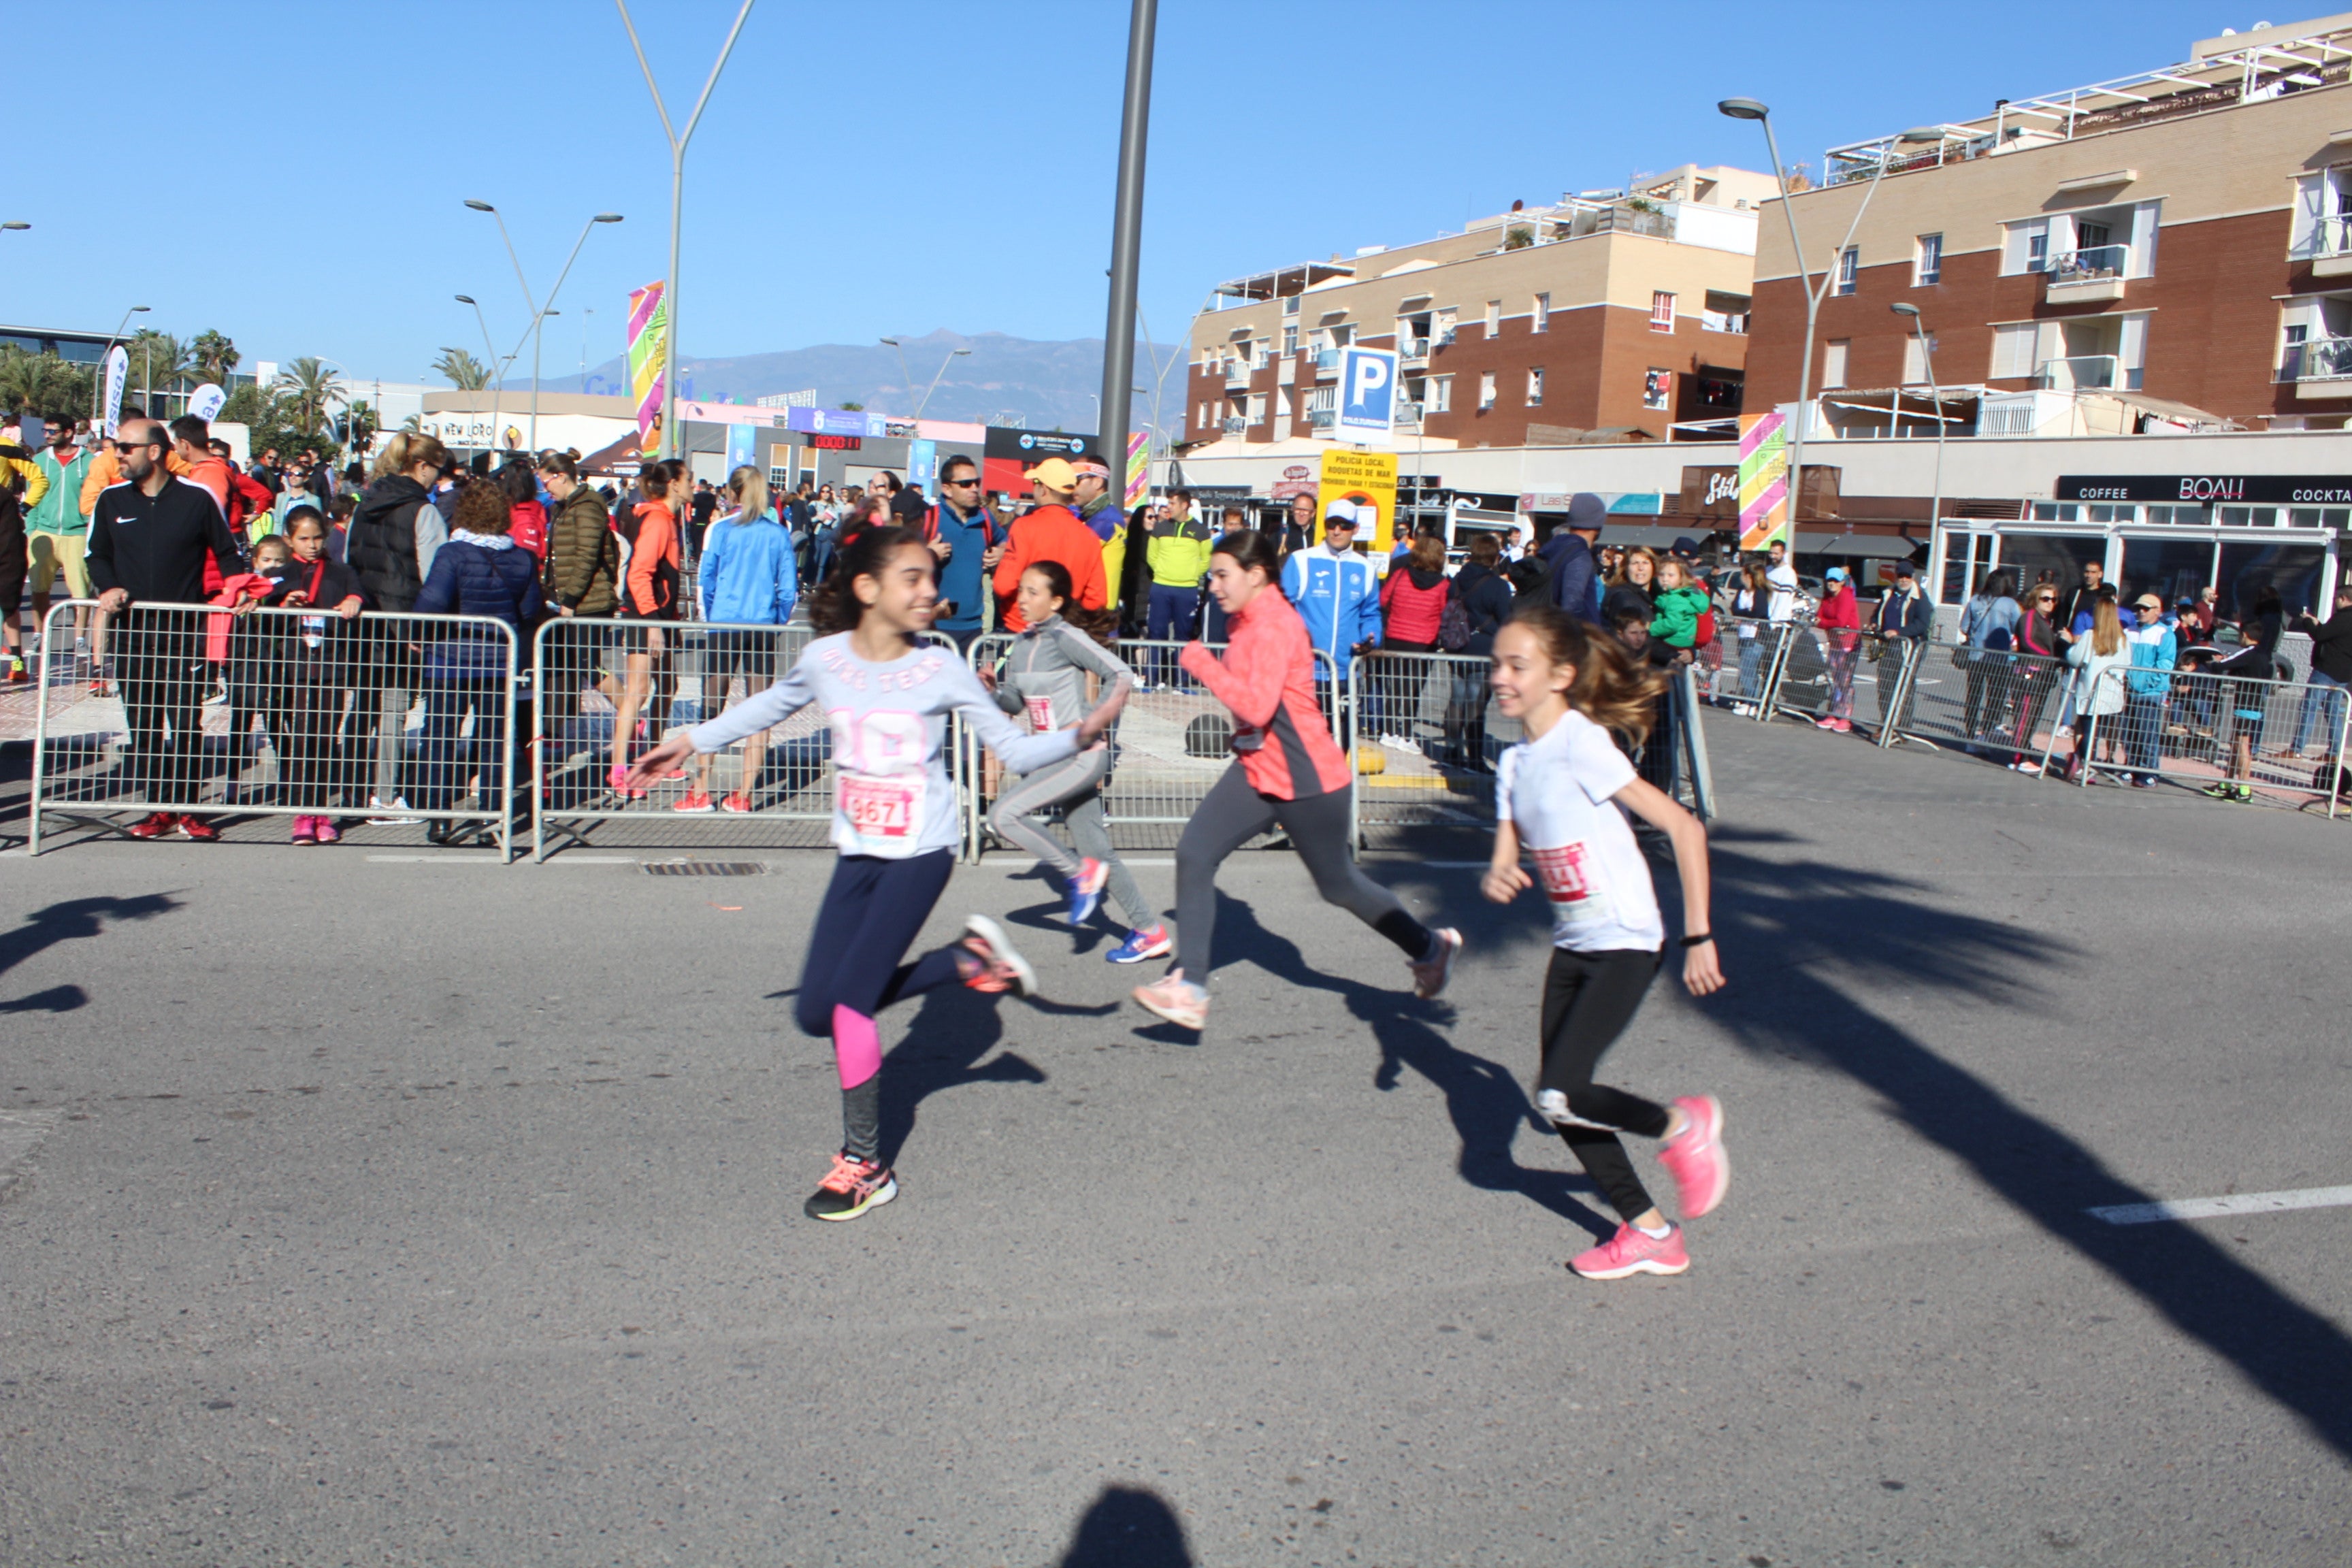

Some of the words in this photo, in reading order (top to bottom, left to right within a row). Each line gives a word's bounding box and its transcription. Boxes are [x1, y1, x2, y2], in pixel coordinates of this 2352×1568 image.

[1353, 356, 1387, 404] P
[445, 425, 463, 436] NEW
[468, 425, 493, 437] LORO
[1336, 456, 1362, 465] POLICIA
[1365, 458, 1384, 467] LOCAL
[1328, 466, 1362, 475] ROQUETAS
[2080, 488, 2128, 499] COFFEE
[1541, 494, 1561, 505] Las
[852, 798, 896, 823] 967
